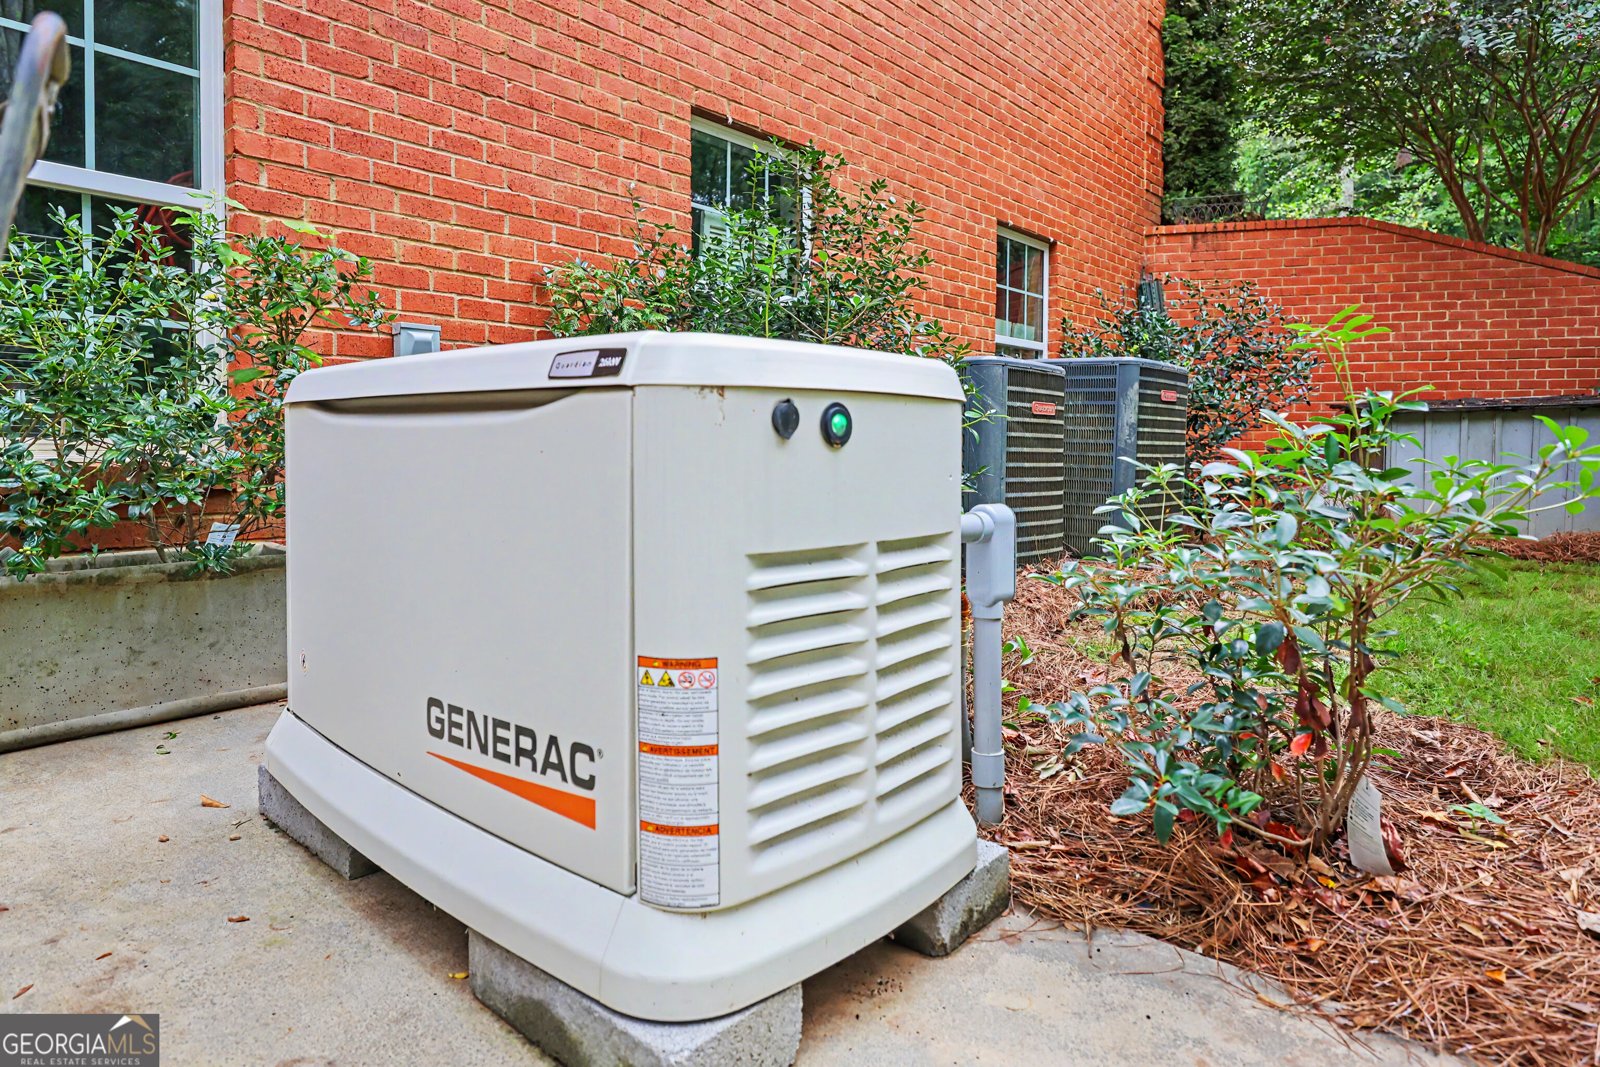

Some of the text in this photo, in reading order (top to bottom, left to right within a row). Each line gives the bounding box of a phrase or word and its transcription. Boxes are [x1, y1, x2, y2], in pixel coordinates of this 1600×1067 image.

[555, 361, 592, 369] Guardian
[662, 660, 702, 668] WARNING
[426, 696, 596, 791] GENERAC
